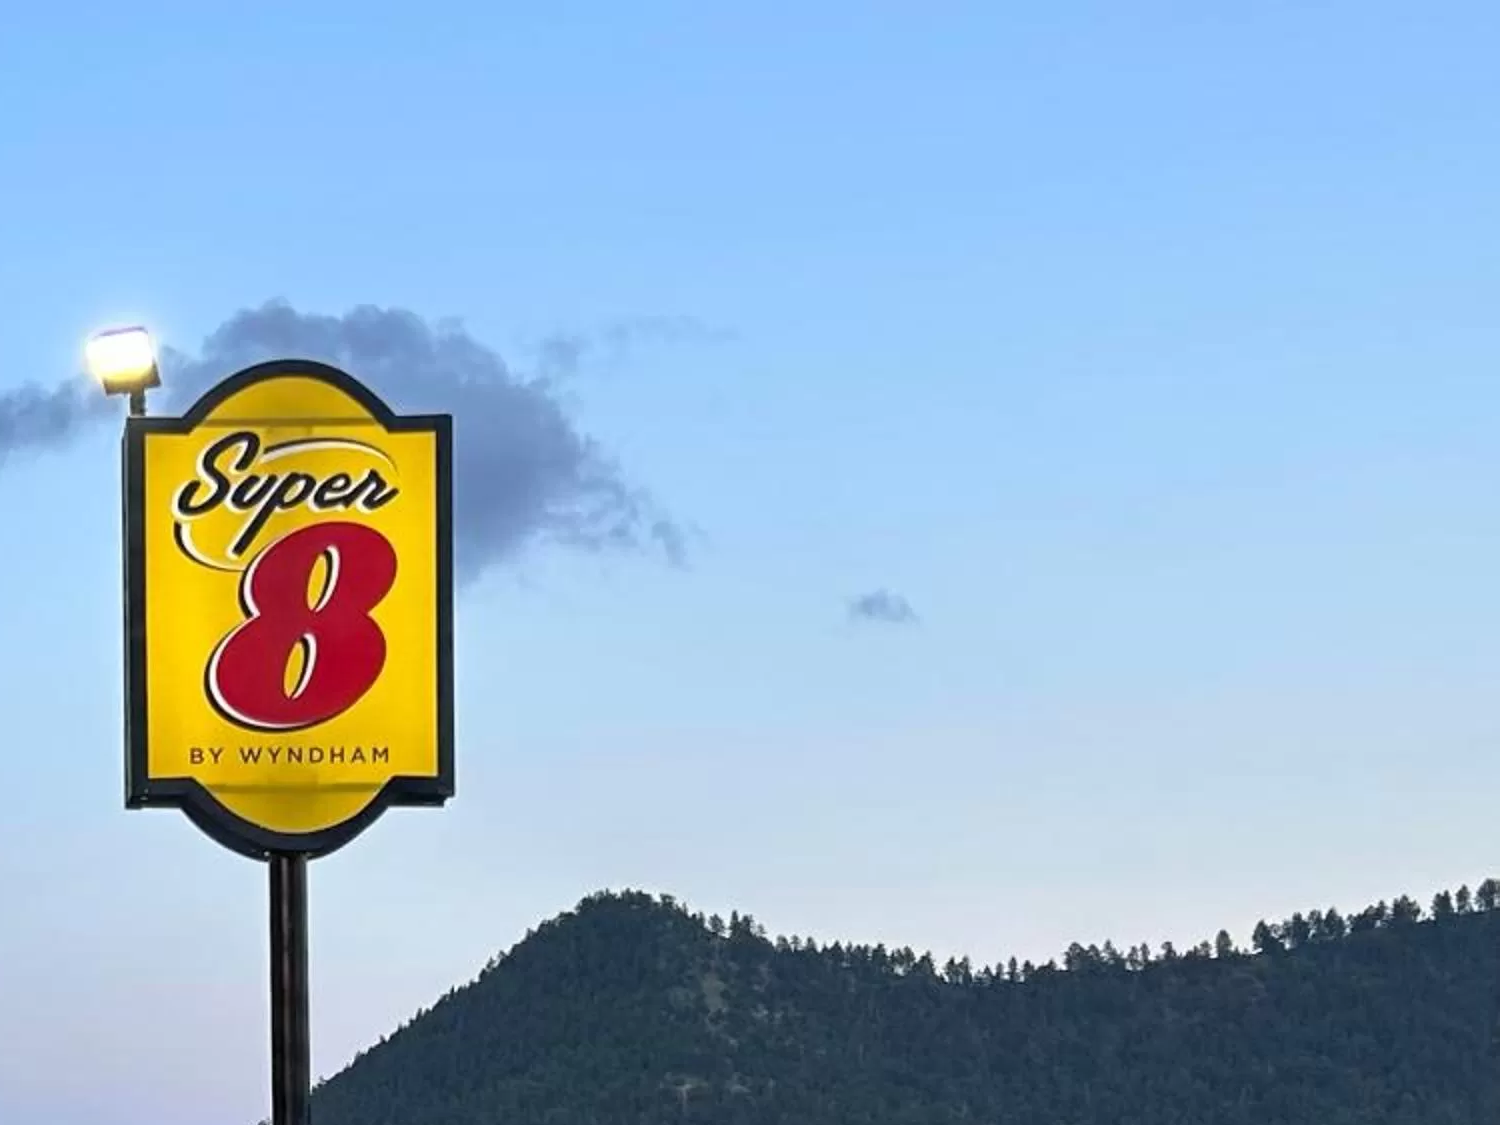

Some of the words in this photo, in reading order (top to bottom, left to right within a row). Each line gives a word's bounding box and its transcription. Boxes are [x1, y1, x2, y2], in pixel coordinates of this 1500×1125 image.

[176, 431, 399, 557] Super
[204, 521, 398, 733] 8
[189, 747, 222, 765] BY
[239, 746, 390, 764] WYNDHAM
